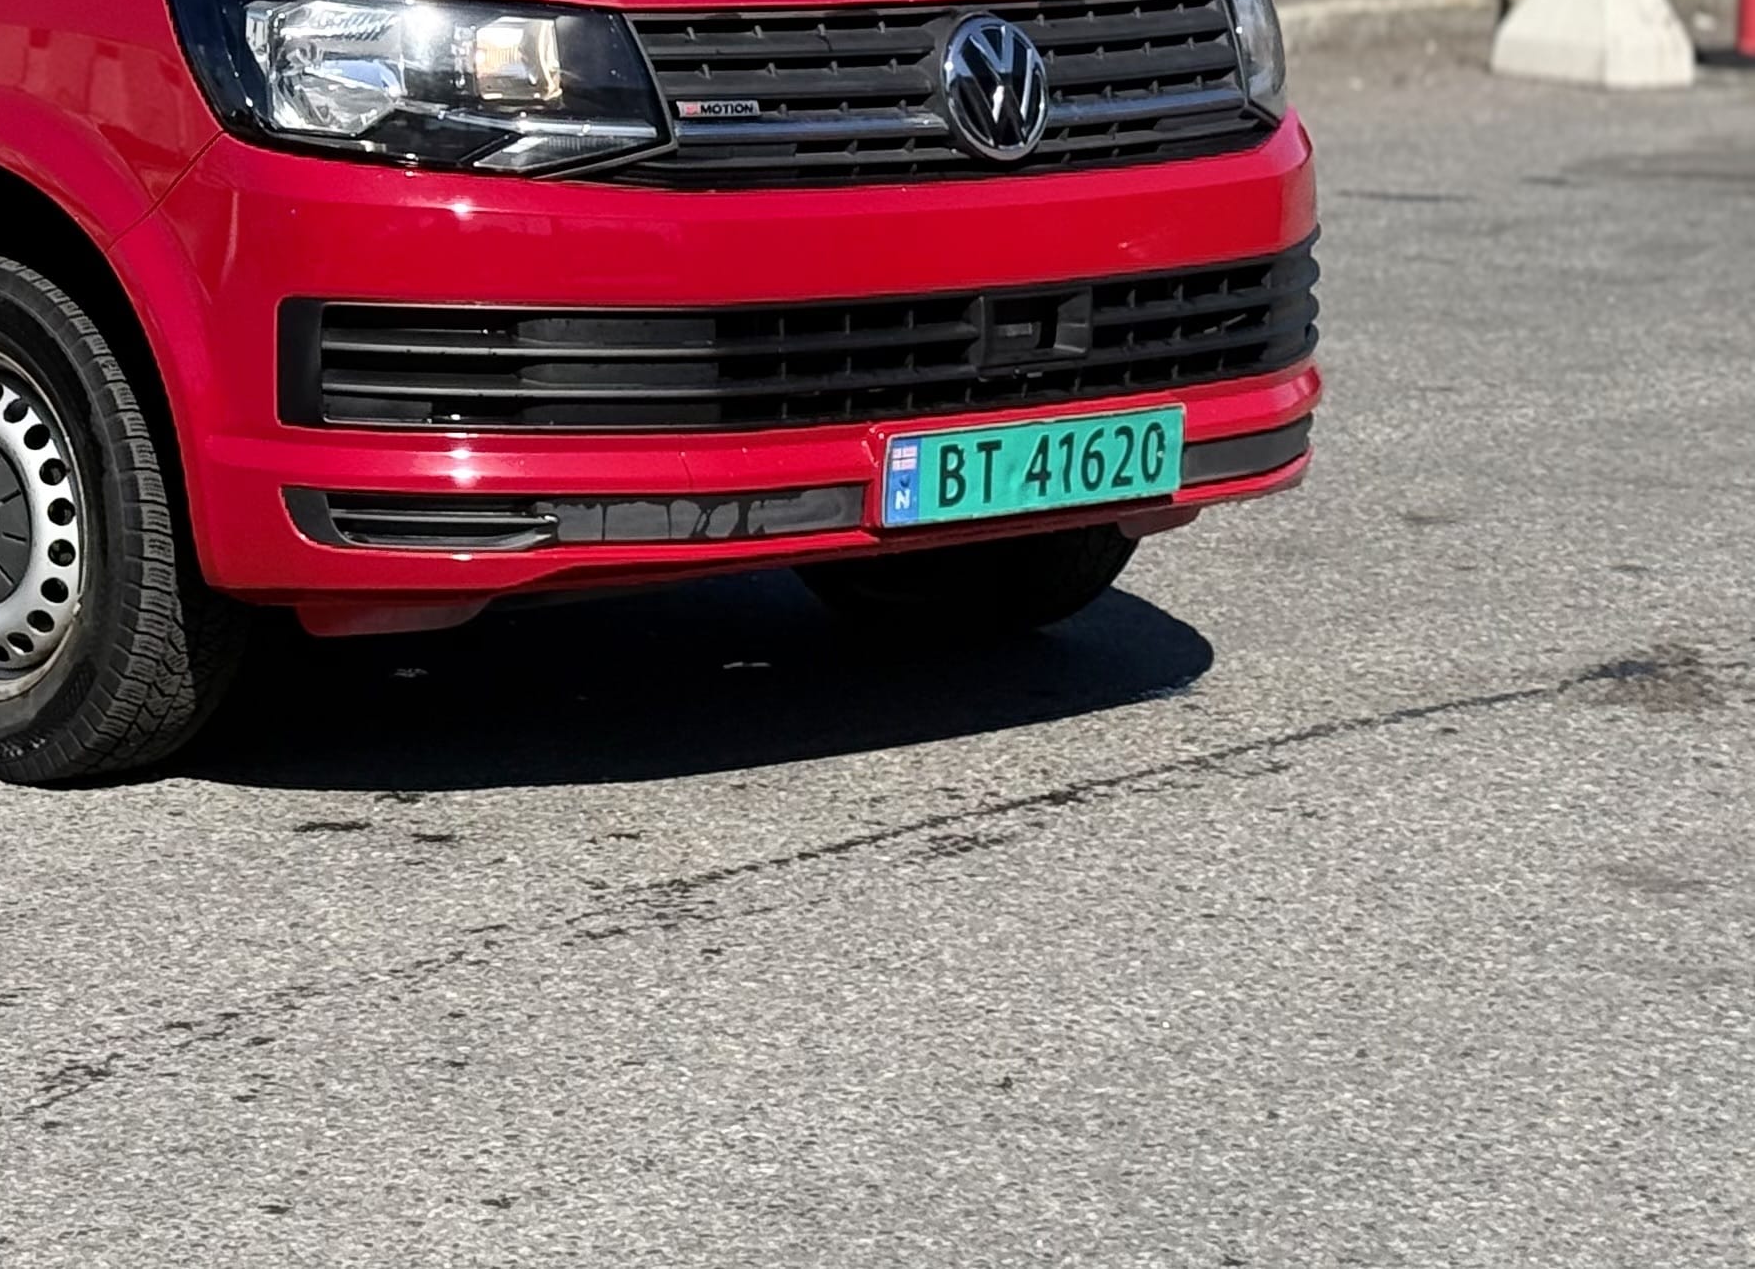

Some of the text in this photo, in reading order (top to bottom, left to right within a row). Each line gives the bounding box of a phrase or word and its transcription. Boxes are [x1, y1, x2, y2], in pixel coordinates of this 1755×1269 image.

[944, 14, 1046, 158] VW
[895, 489, 910, 509] N
[938, 421, 1166, 508] BT 41620
